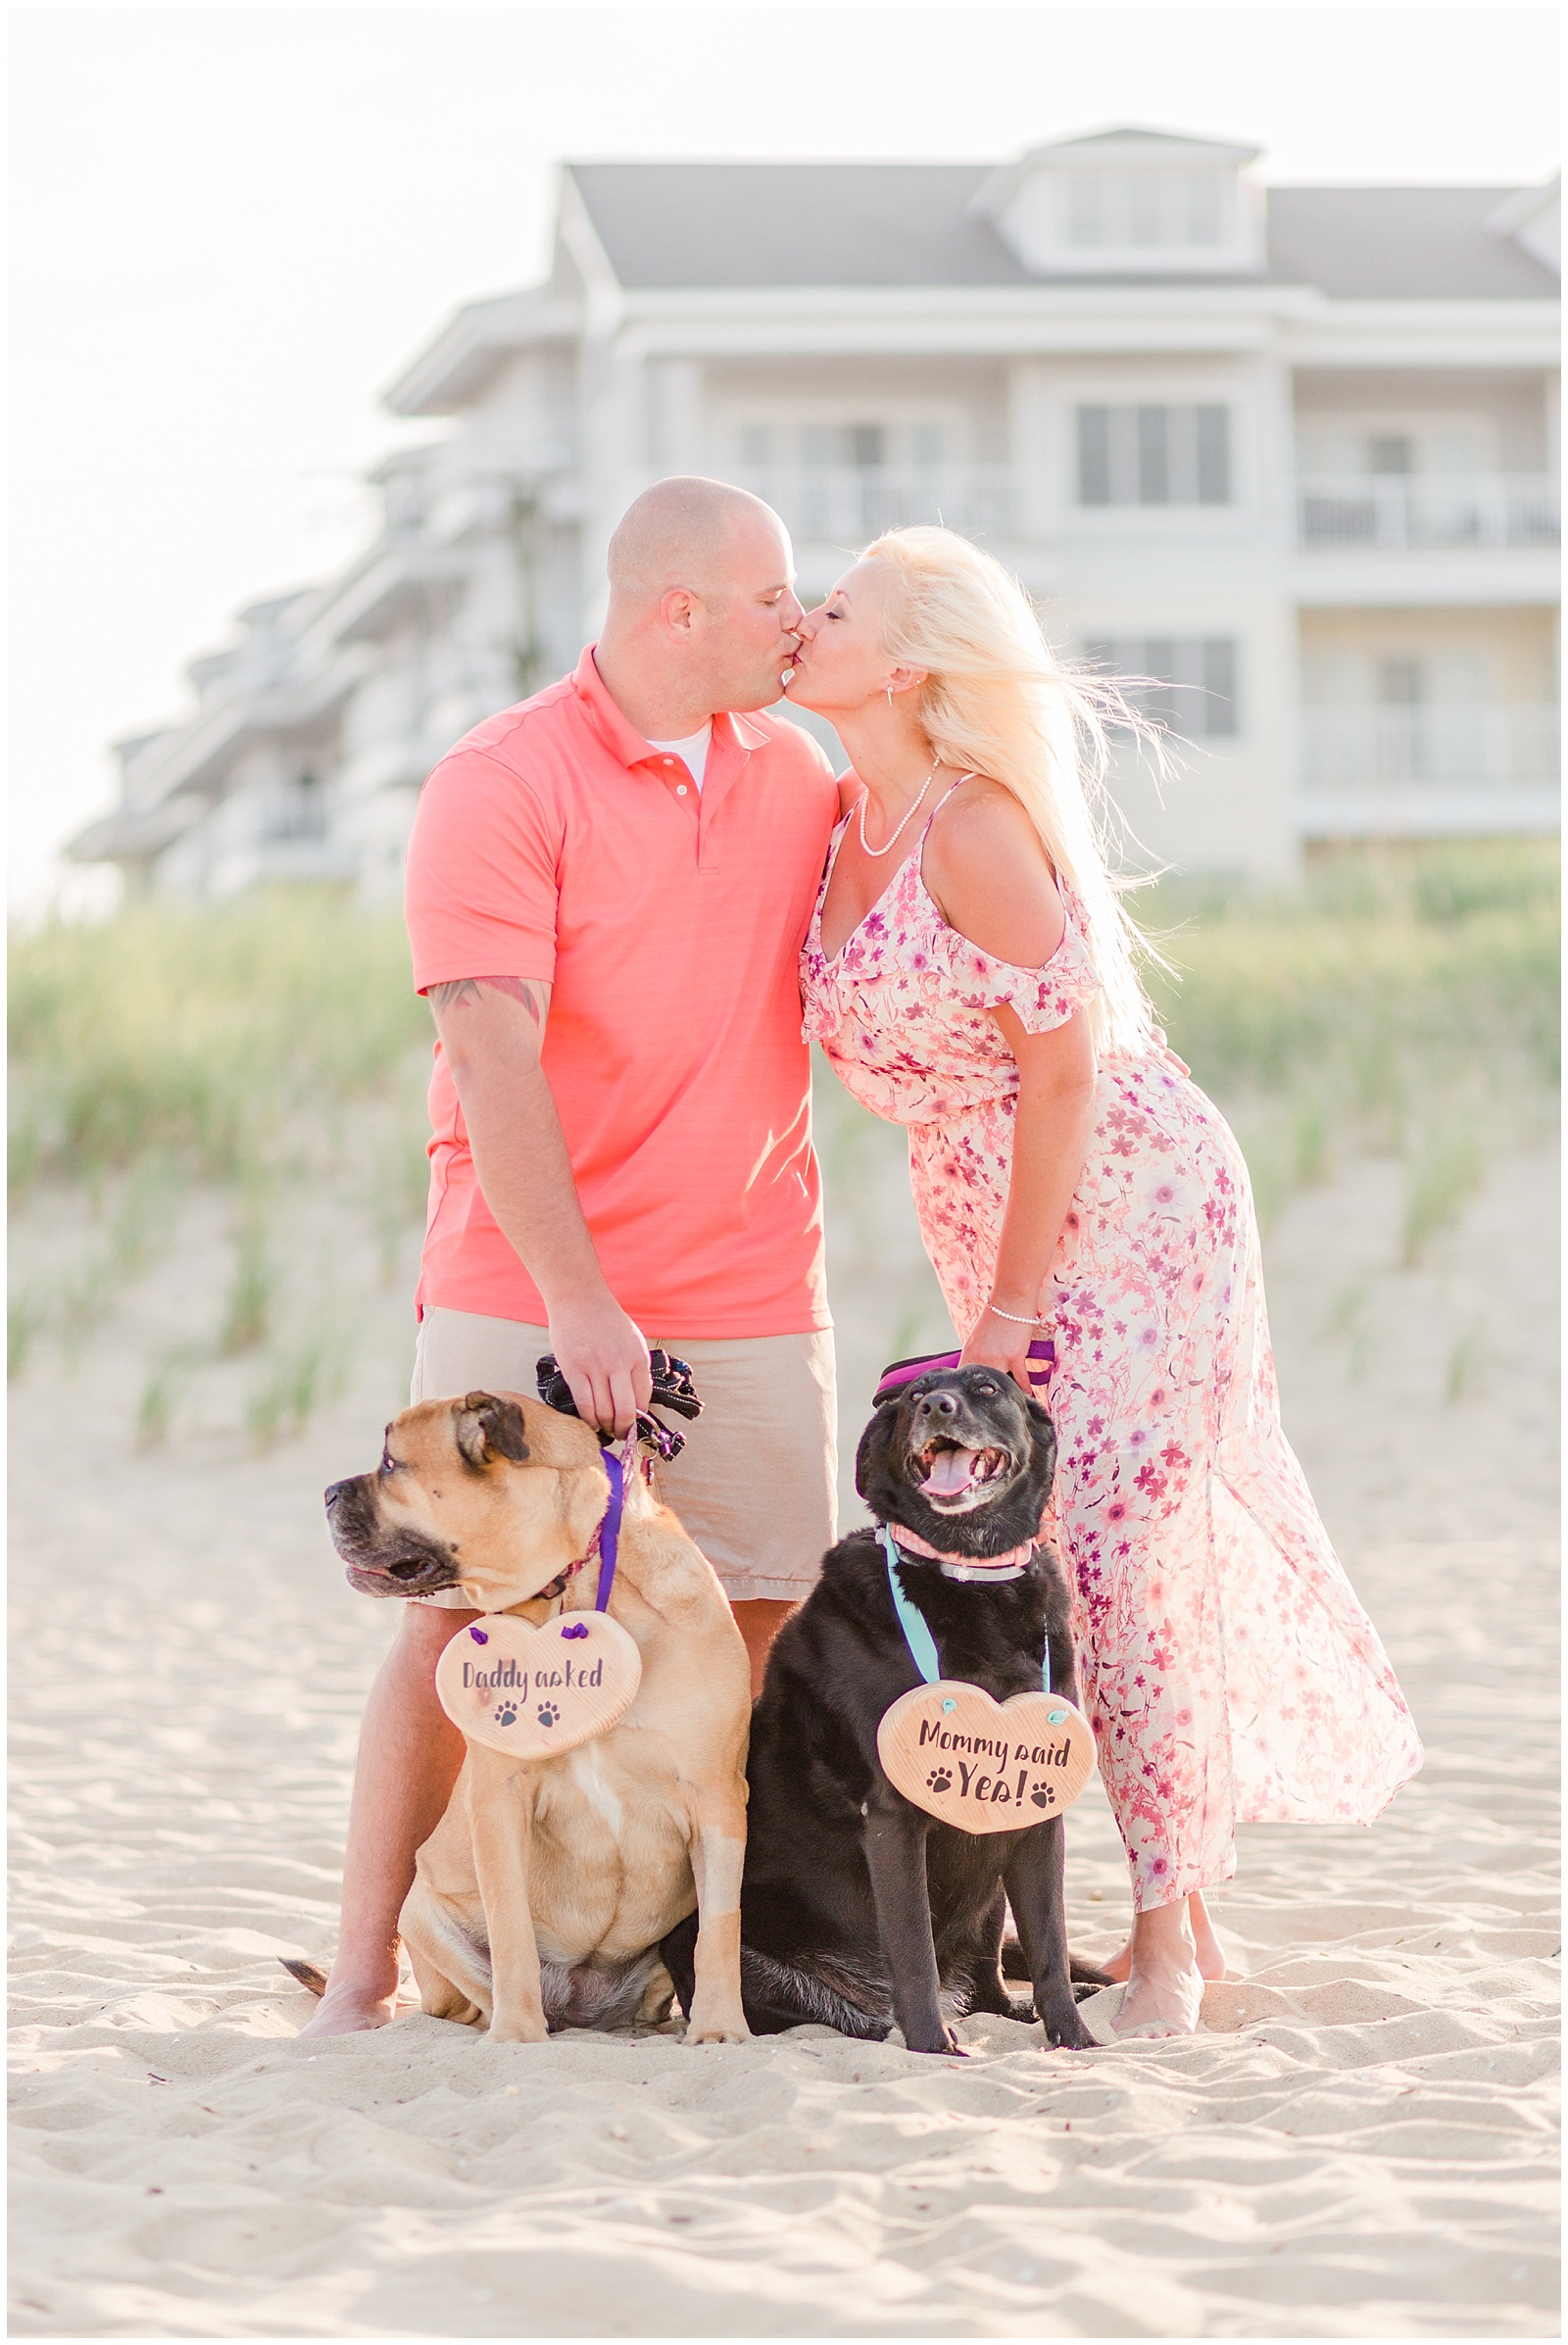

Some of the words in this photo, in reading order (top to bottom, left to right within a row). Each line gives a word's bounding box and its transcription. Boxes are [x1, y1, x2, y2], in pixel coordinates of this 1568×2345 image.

[464, 1659, 528, 1703] Daddy
[536, 1658, 603, 1687] asked
[919, 1719, 1007, 1774] Mommy
[1014, 1738, 1070, 1767] said
[958, 1761, 1028, 1806] Yes!
